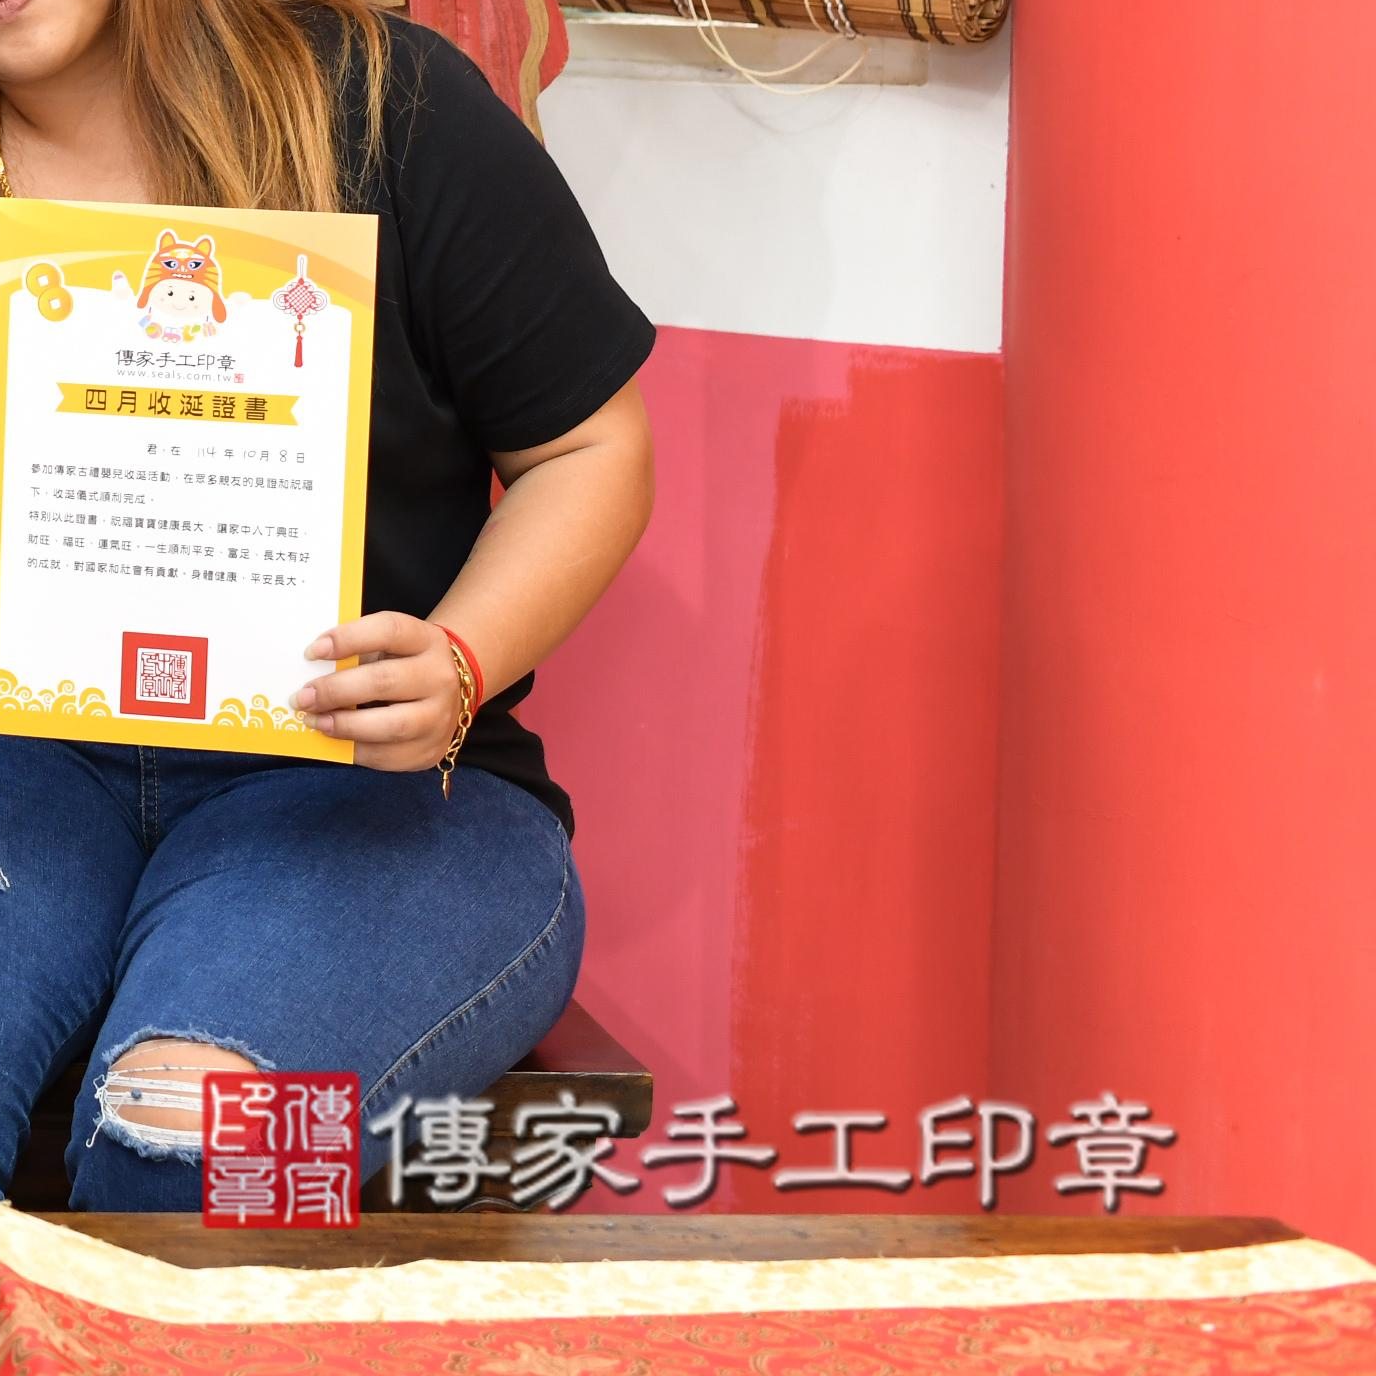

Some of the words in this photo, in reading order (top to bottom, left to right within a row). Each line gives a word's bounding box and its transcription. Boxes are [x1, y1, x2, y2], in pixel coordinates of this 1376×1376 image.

[115, 349, 236, 372] 傳家手工印章
[116, 368, 232, 384] www.seals.com.tw
[85, 388, 269, 421] 四月收涎證書
